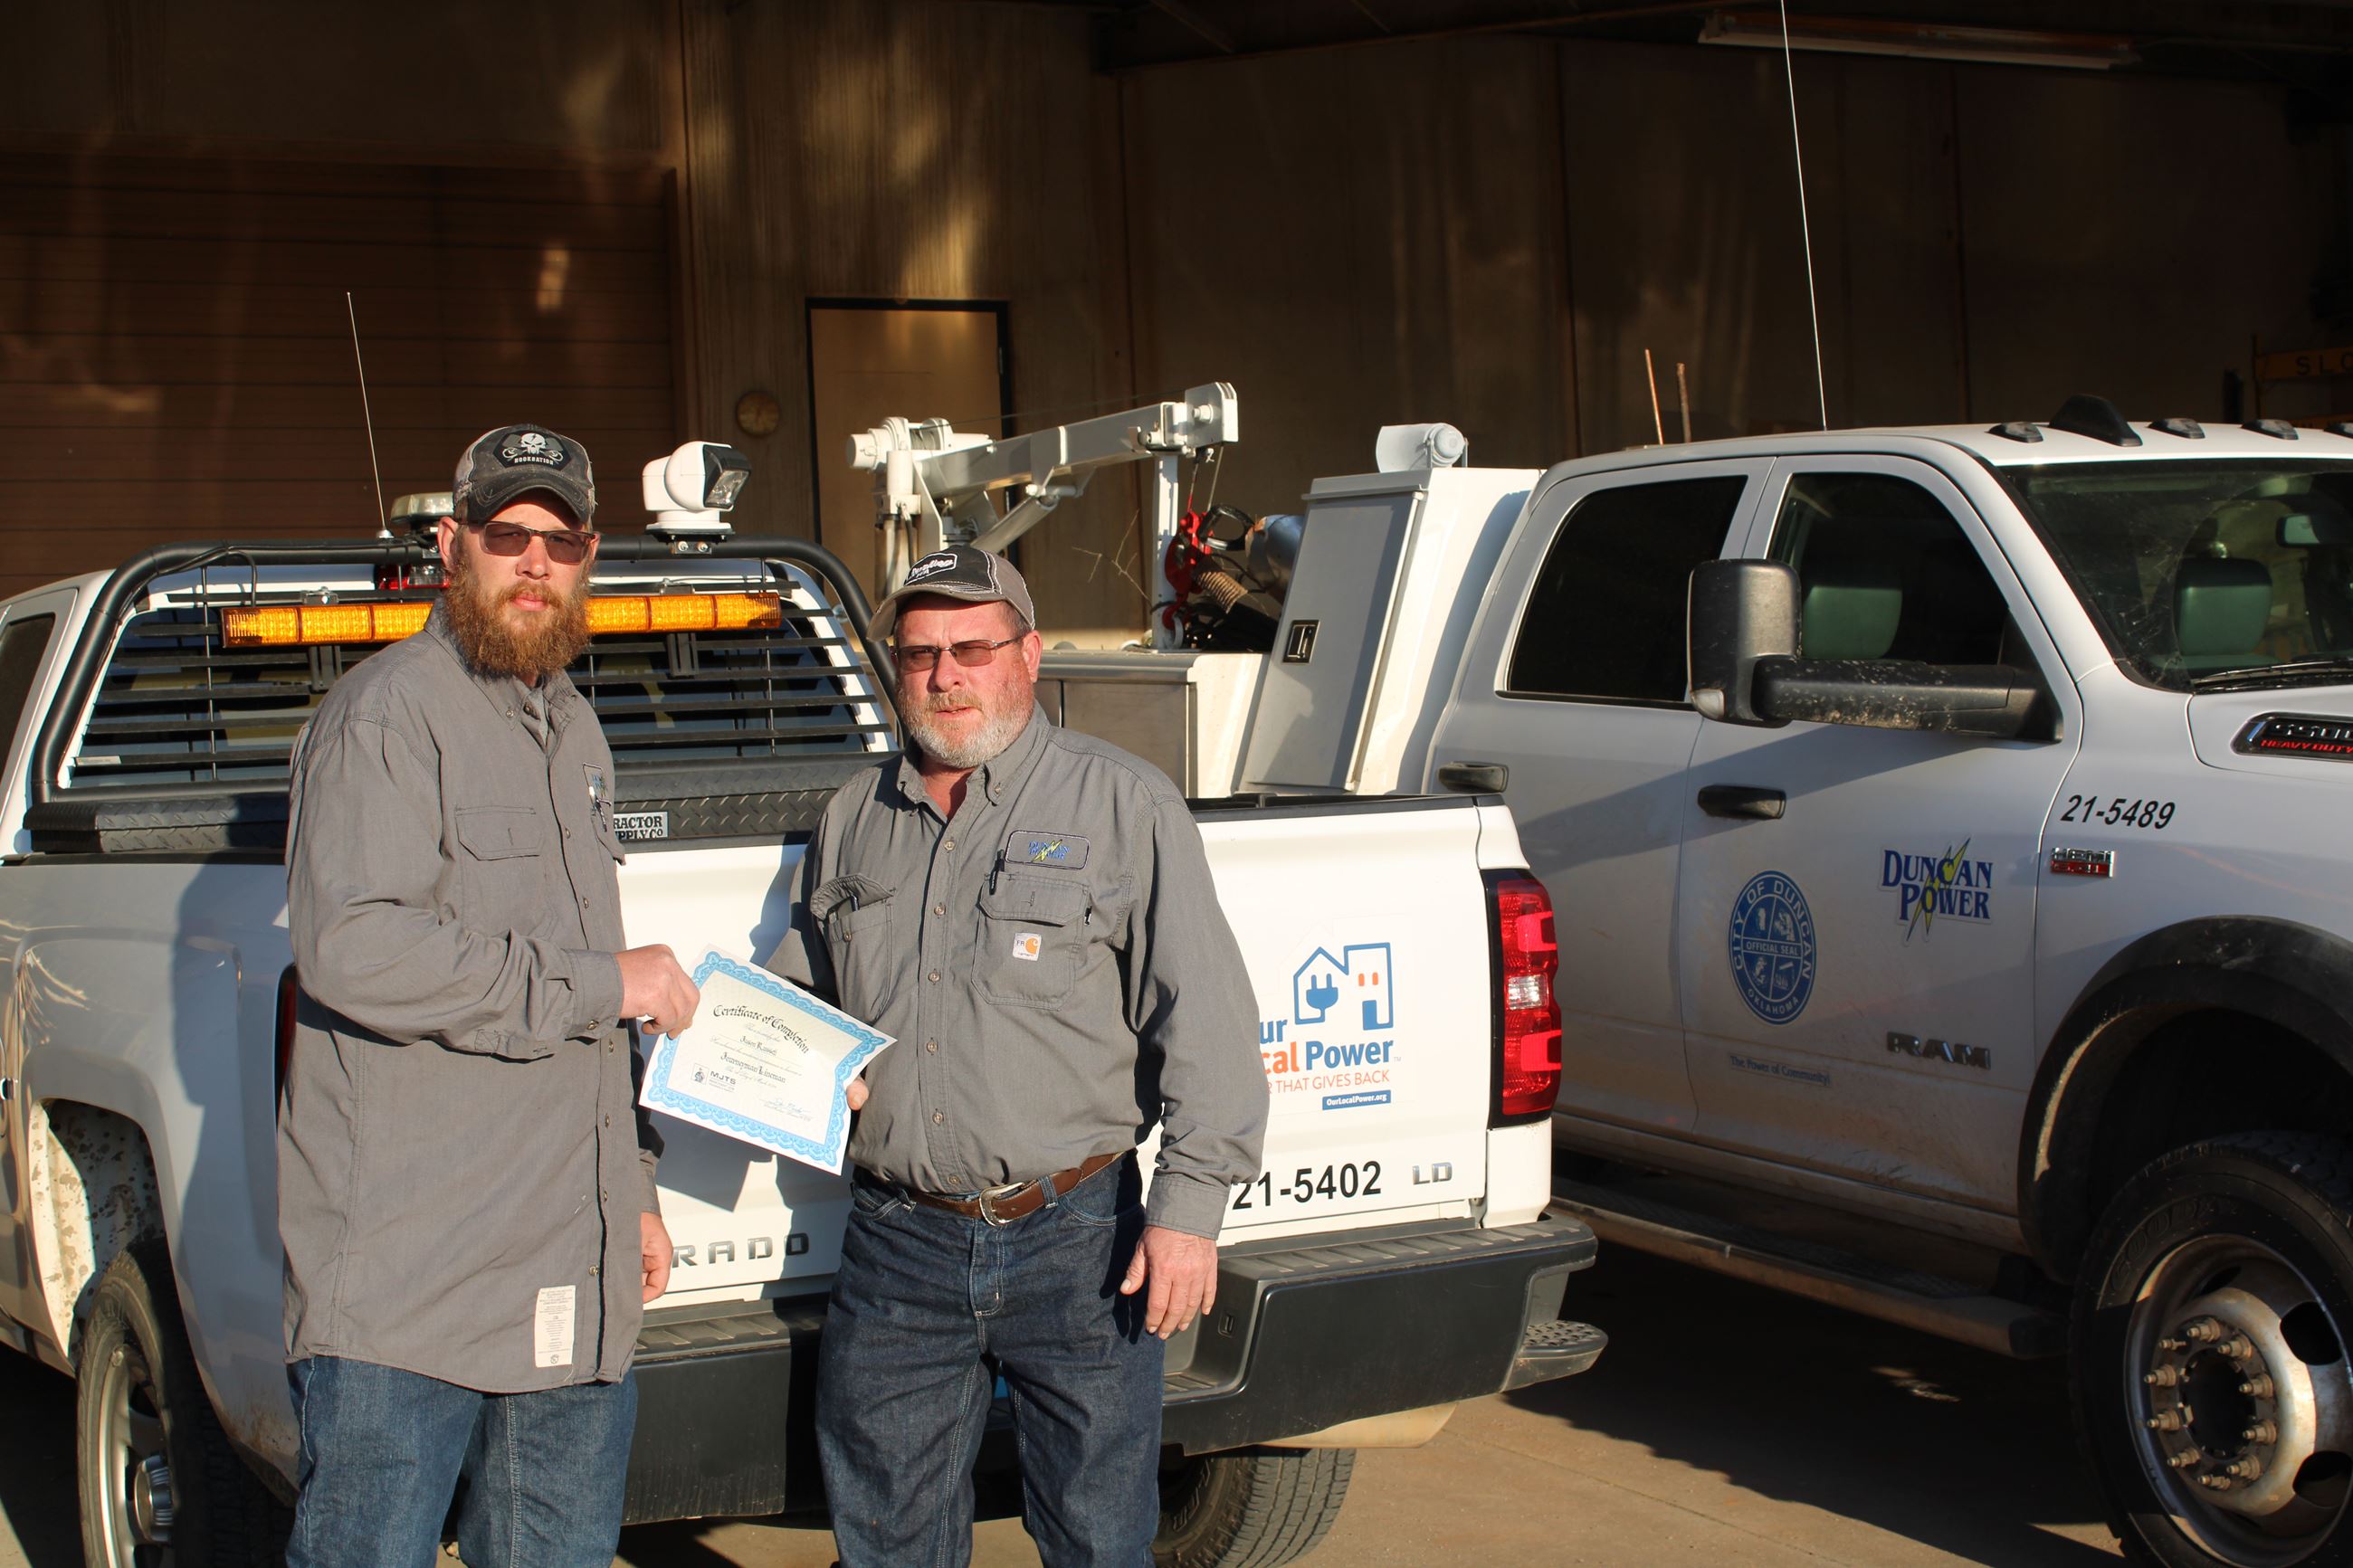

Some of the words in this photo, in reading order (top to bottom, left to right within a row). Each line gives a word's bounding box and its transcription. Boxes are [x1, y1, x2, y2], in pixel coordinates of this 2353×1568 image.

[2295, 352, 2353, 376] SLO
[2261, 739, 2311, 750] HEAVY
[614, 816, 662, 830] RACTOR
[2061, 794, 2176, 830] 21-5489
[1881, 850, 1994, 889] DUNCAN
[1899, 883, 1991, 921] POWER
[1732, 910, 1746, 971] CITY
[1747, 881, 1766, 906] OF
[1773, 879, 1813, 980] DUNCAN
[1746, 941, 1779, 954] OFFICIAL
[1780, 945, 1799, 956] SEAL
[1747, 988, 1800, 1015] OKLAHOMA
[713, 1004, 762, 1021] Certificate
[761, 1015, 775, 1024] of
[771, 1018, 810, 1054] Completion
[1259, 1019, 1288, 1044] ur
[1262, 1042, 1299, 1074] cal
[1306, 1038, 1394, 1071] Power
[1887, 1031, 1992, 1070] RAM
[710, 1070, 737, 1085] MJTS
[1729, 1055, 1746, 1069] The
[1747, 1058, 1769, 1073] Power
[1770, 1063, 1780, 1074] of
[1276, 1078, 1310, 1094] THAT
[1312, 1073, 1351, 1090] GIVES
[1354, 1069, 1390, 1086] BACK
[1326, 1093, 1387, 1106] OurLocalPower.org
[1232, 1160, 1382, 1211] 21-5402
[1412, 1161, 1453, 1185] LD
[672, 1232, 810, 1269] RADO
